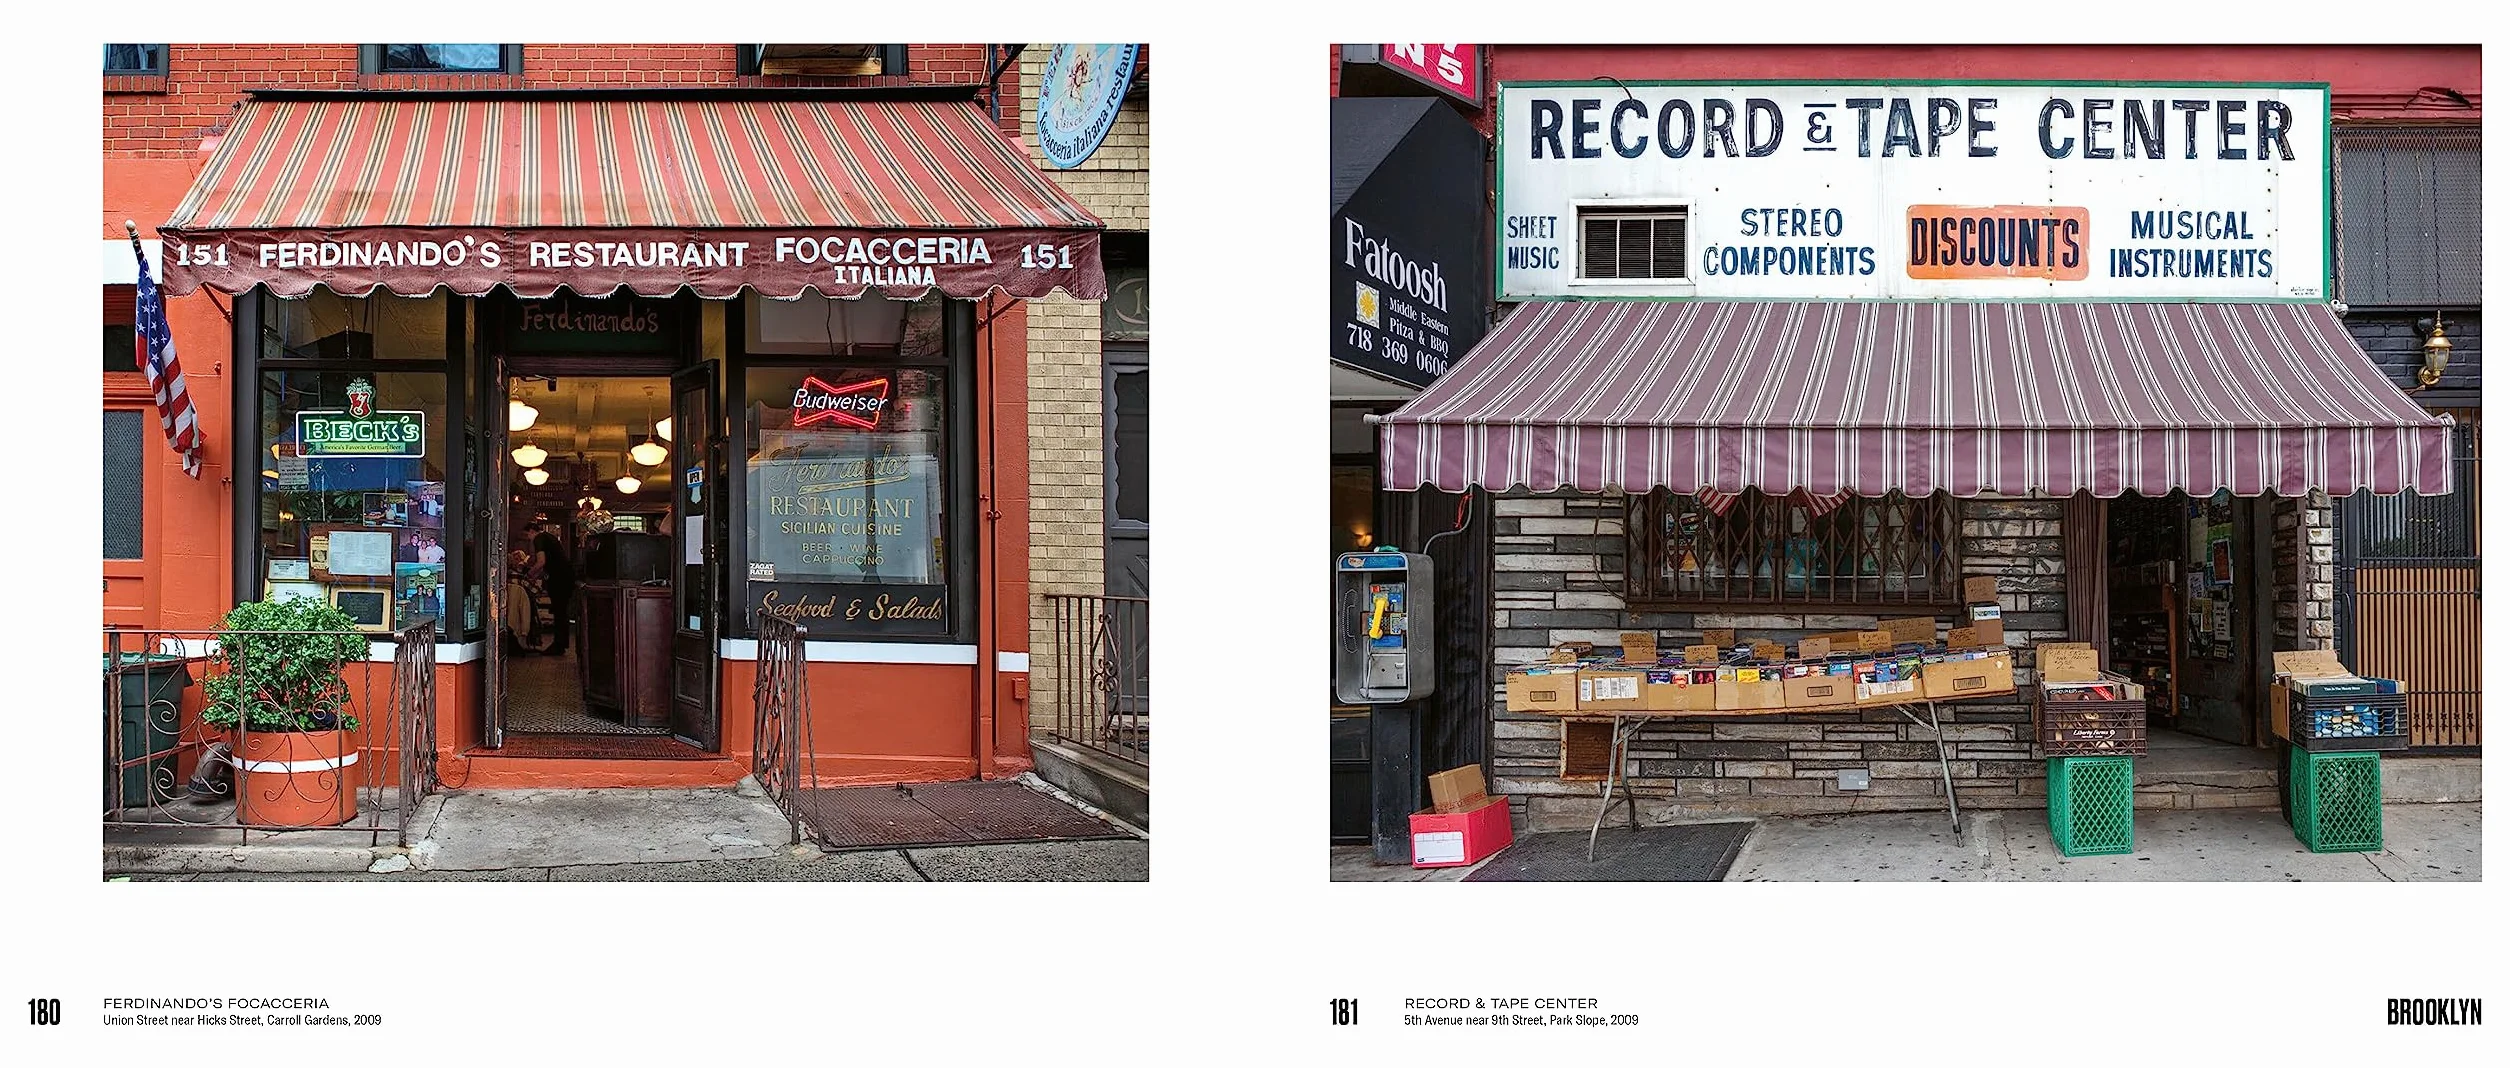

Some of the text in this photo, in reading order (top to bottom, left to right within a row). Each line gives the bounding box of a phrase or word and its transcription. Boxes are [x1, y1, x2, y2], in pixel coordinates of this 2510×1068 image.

[1073, 109, 1109, 157] italiana
[1531, 98, 2295, 161] RECORD & TAPE CENTER
[1507, 216, 1557, 238] SHEET
[1740, 208, 1843, 237] STEREO
[2130, 211, 2254, 240] MUSICAL
[176, 244, 229, 267] 151
[259, 235, 992, 268] FERDINANDO'S RESTAURANT FOCACCERIA
[1021, 244, 1074, 269] 151
[1910, 217, 2080, 268] DISCOUNTS
[1345, 217, 1447, 313] Fatoosh
[1508, 246, 1559, 269] MUSIC
[1703, 246, 1876, 276] COMPONENTS
[2109, 248, 2273, 278] INSTRUMENTS
[834, 266, 937, 286] ITALIANA
[519, 302, 660, 334] Ferdinando's
[1389, 297, 1449, 336] Middle Eastern
[1347, 322, 1448, 377] 718 369 0606
[1418, 329, 1426, 347] &
[1431, 335, 1449, 358] BBQ
[793, 388, 888, 412] Budweiser
[770, 496, 915, 519] RESTAURANT
[781, 521, 902, 536] SICILIAN CUISINE
[802, 543, 883, 553] BEER WINE
[802, 554, 885, 566] CAPPUCCINO
[756, 590, 942, 622] Seafood & Salads
